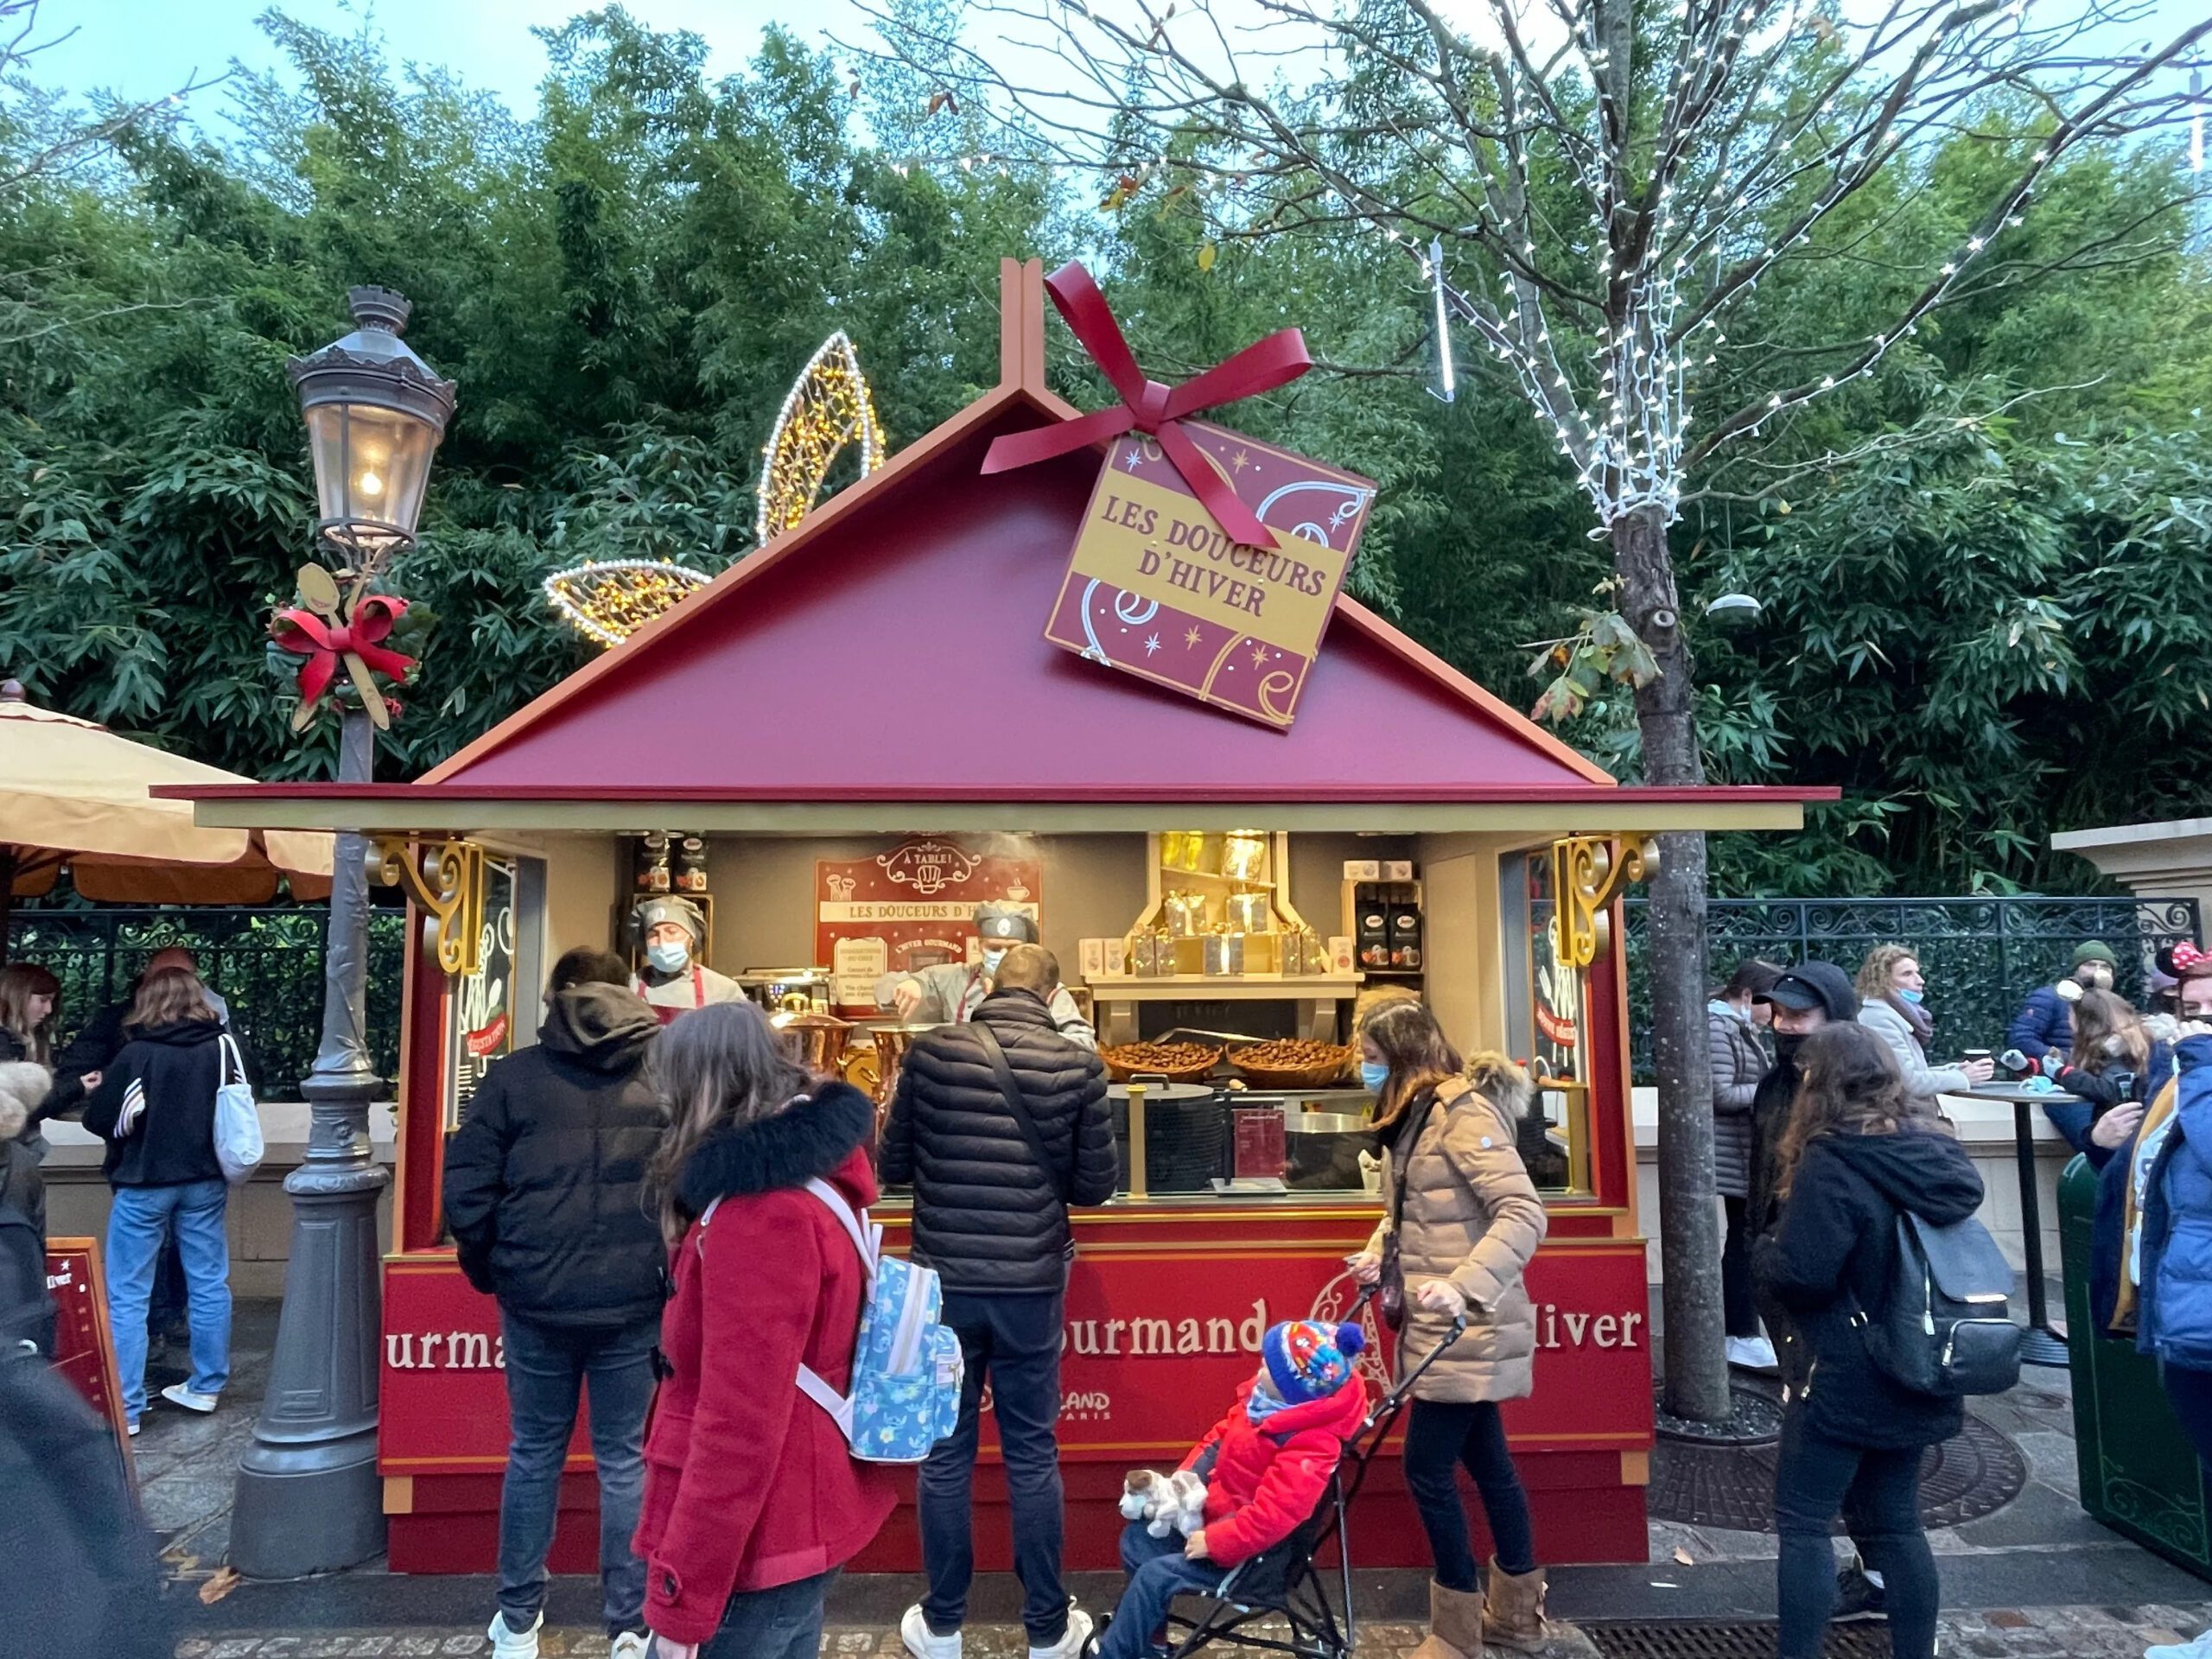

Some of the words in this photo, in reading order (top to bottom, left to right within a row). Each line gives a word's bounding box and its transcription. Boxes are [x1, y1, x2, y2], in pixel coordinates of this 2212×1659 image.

[1101, 495, 1159, 536] LES
[1165, 519, 1326, 597] DOUCEURS
[1136, 549, 1267, 618] D'HIVER
[849, 907, 873, 918] LES
[879, 906, 948, 918] DOUCEURS
[953, 905, 977, 918] D'H
[1060, 1298, 1267, 1355] urmand
[1532, 1304, 1642, 1348] iver
[1058, 1412, 1110, 1421] ARIS
